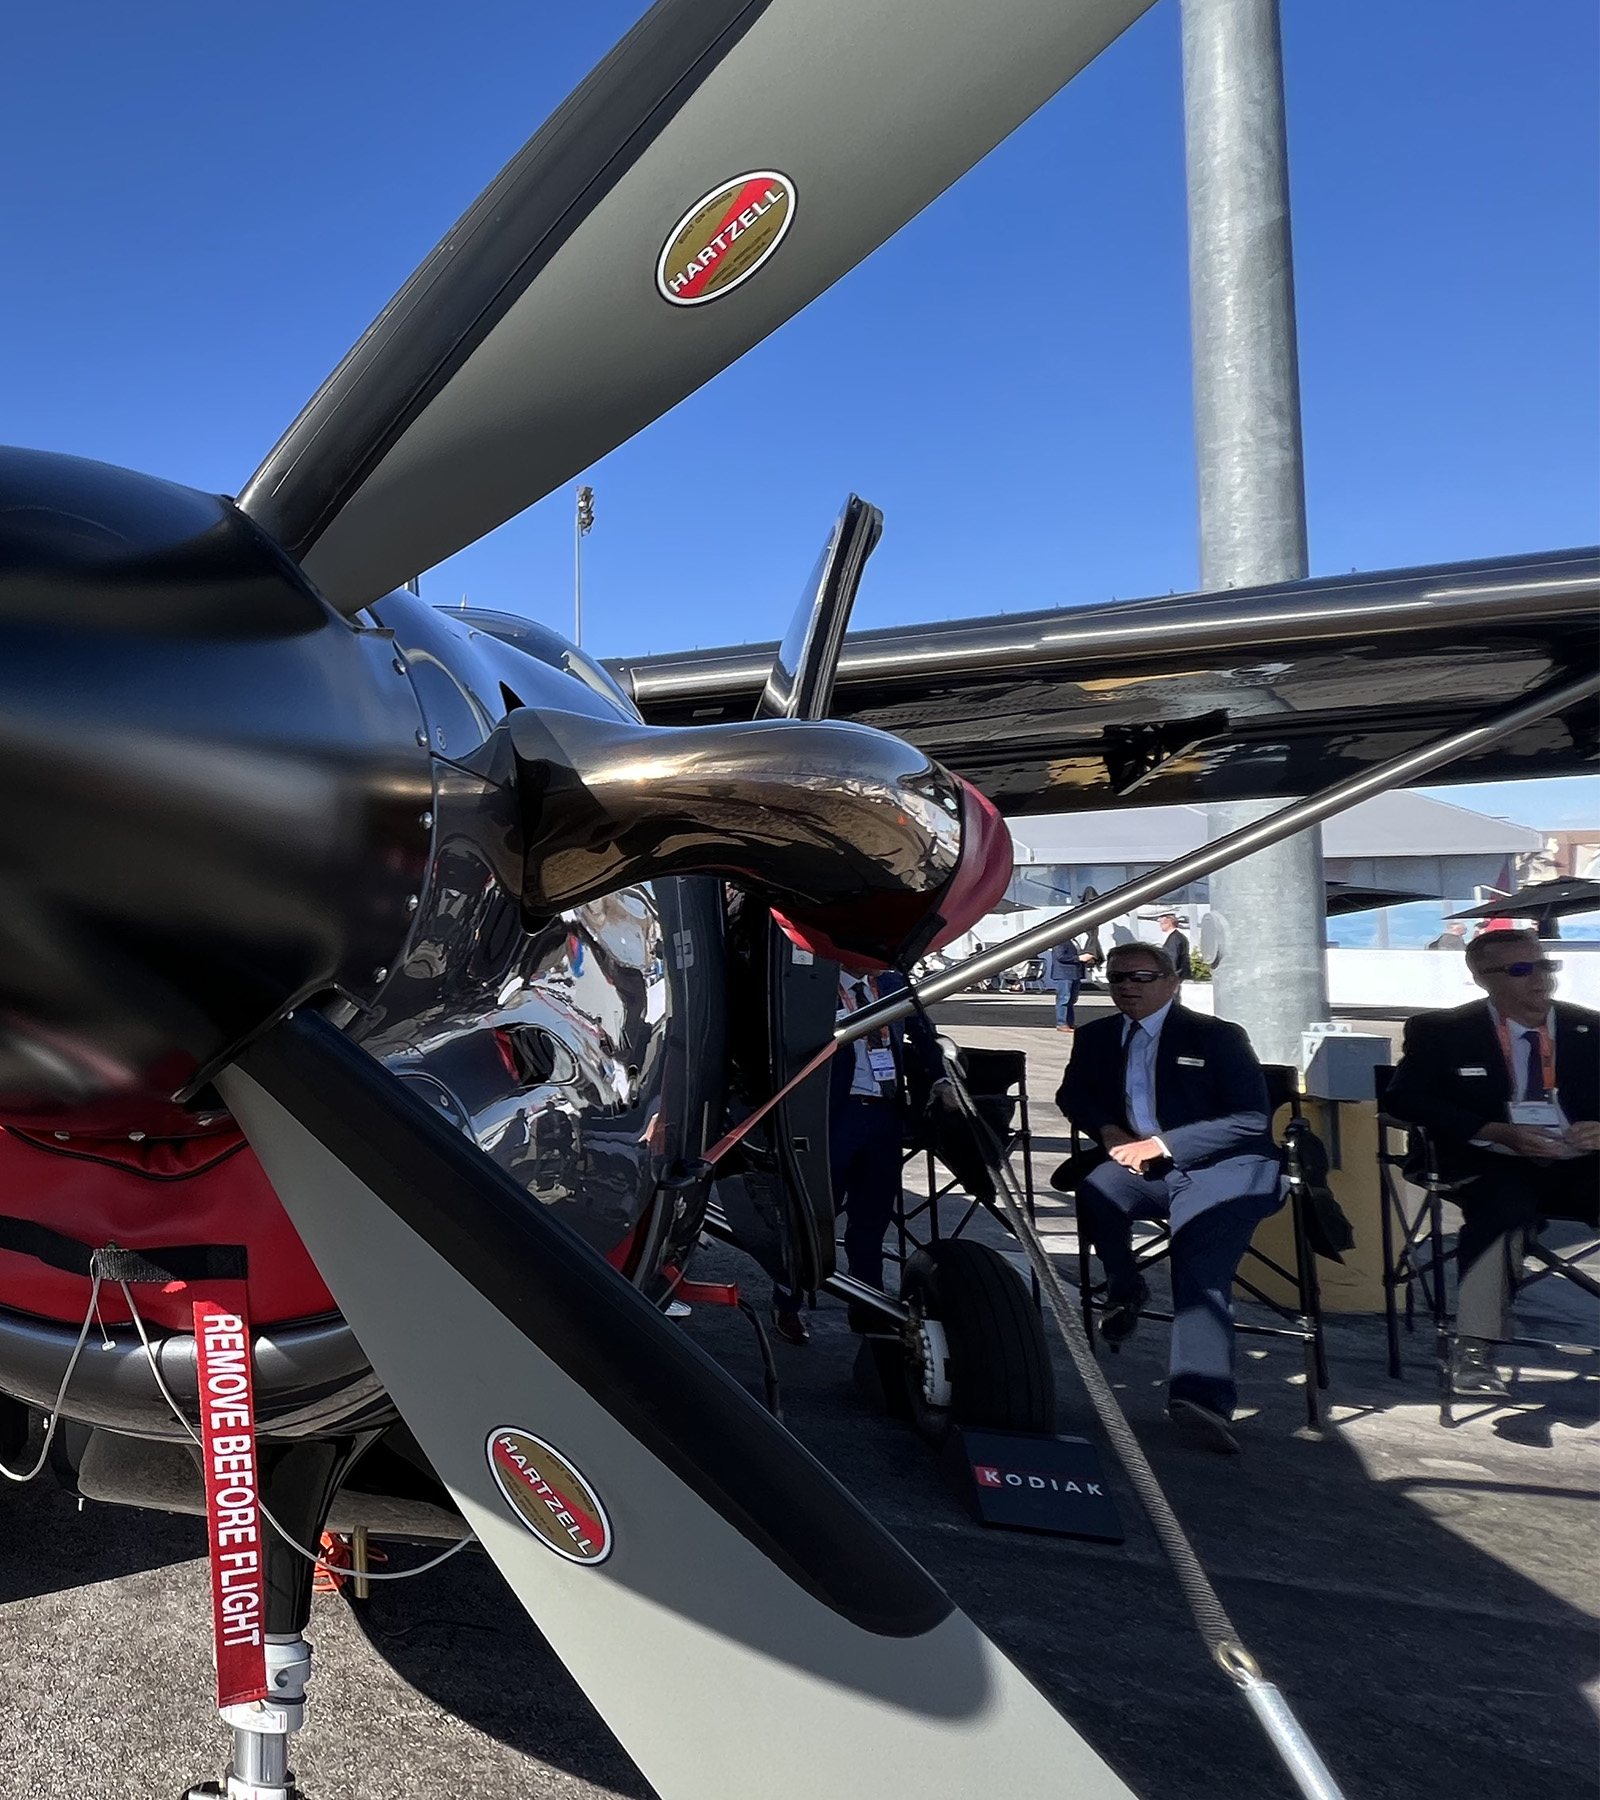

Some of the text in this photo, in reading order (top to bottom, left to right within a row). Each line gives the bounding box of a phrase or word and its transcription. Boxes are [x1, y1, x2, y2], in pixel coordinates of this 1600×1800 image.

[668, 190, 786, 293] HARTZELL
[203, 1314, 261, 1648] REMOVE BEFORE FLIGHT
[498, 1436, 592, 1556] HARTZELL
[984, 1470, 1104, 1497] KODIAK
